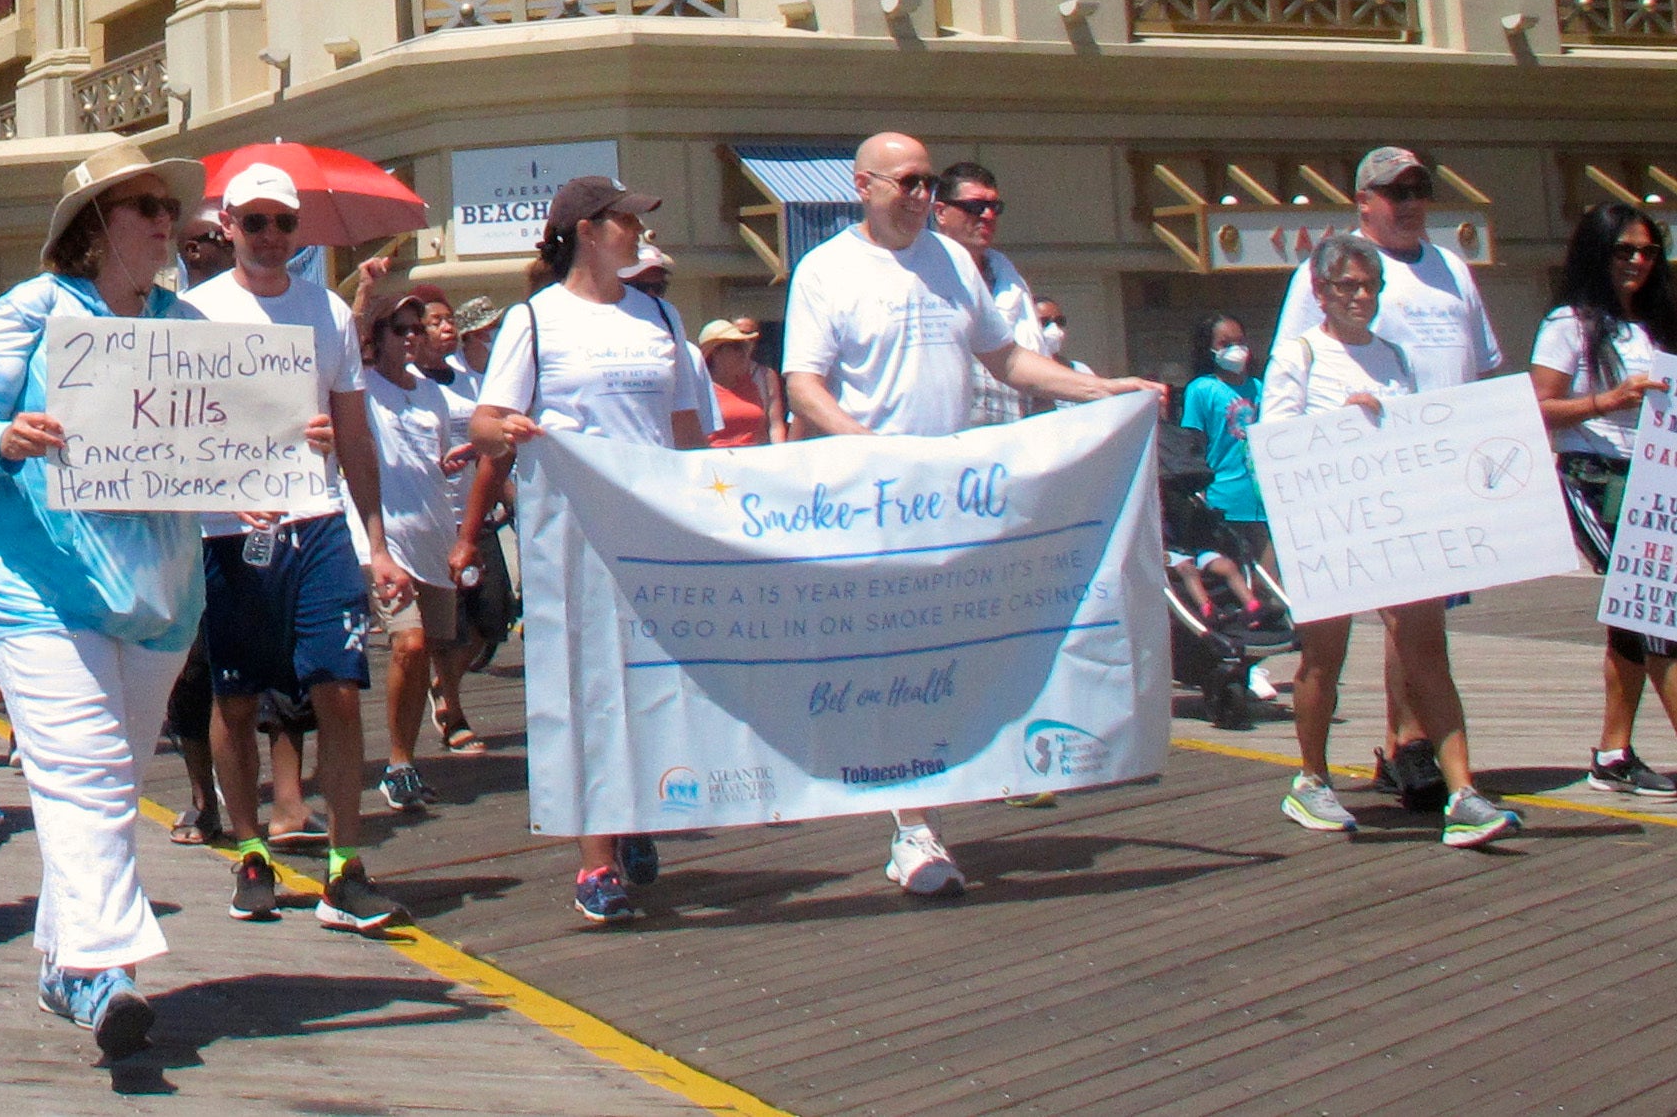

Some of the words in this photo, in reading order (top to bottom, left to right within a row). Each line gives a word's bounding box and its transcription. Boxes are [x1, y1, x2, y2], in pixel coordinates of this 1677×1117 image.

[521, 227, 542, 238] BA
[58, 323, 136, 389] 2nd
[132, 386, 227, 430] Kills
[1266, 402, 1452, 460] CASNO
[238, 468, 326, 502] COPD
[1274, 439, 1457, 503] EMPLOYEES
[740, 477, 946, 538] Smoke-Free
[956, 462, 1008, 518] AC
[1286, 490, 1404, 550] LIVES
[633, 585, 717, 605] AFTER
[729, 586, 745, 604] A
[759, 585, 781, 604] 15
[794, 582, 856, 603] YEAR
[867, 568, 993, 598] EXEMPTION
[1002, 558, 1032, 578] IT'S
[1041, 549, 1082, 570] TIME
[1298, 525, 1500, 599] MATTER
[628, 618, 658, 638] TO
[671, 619, 716, 638] GO
[728, 620, 770, 639] ALL
[784, 618, 807, 637] IN
[820, 616, 853, 635] ON
[866, 606, 943, 632] SMOKE
[952, 597, 1001, 621] FREE
[1008, 580, 1109, 613] CASINOS
[857, 689, 881, 706] on
[888, 658, 958, 707] Health
[709, 766, 773, 782] ATLANTIC
[841, 758, 947, 784] Tobacco-Free
